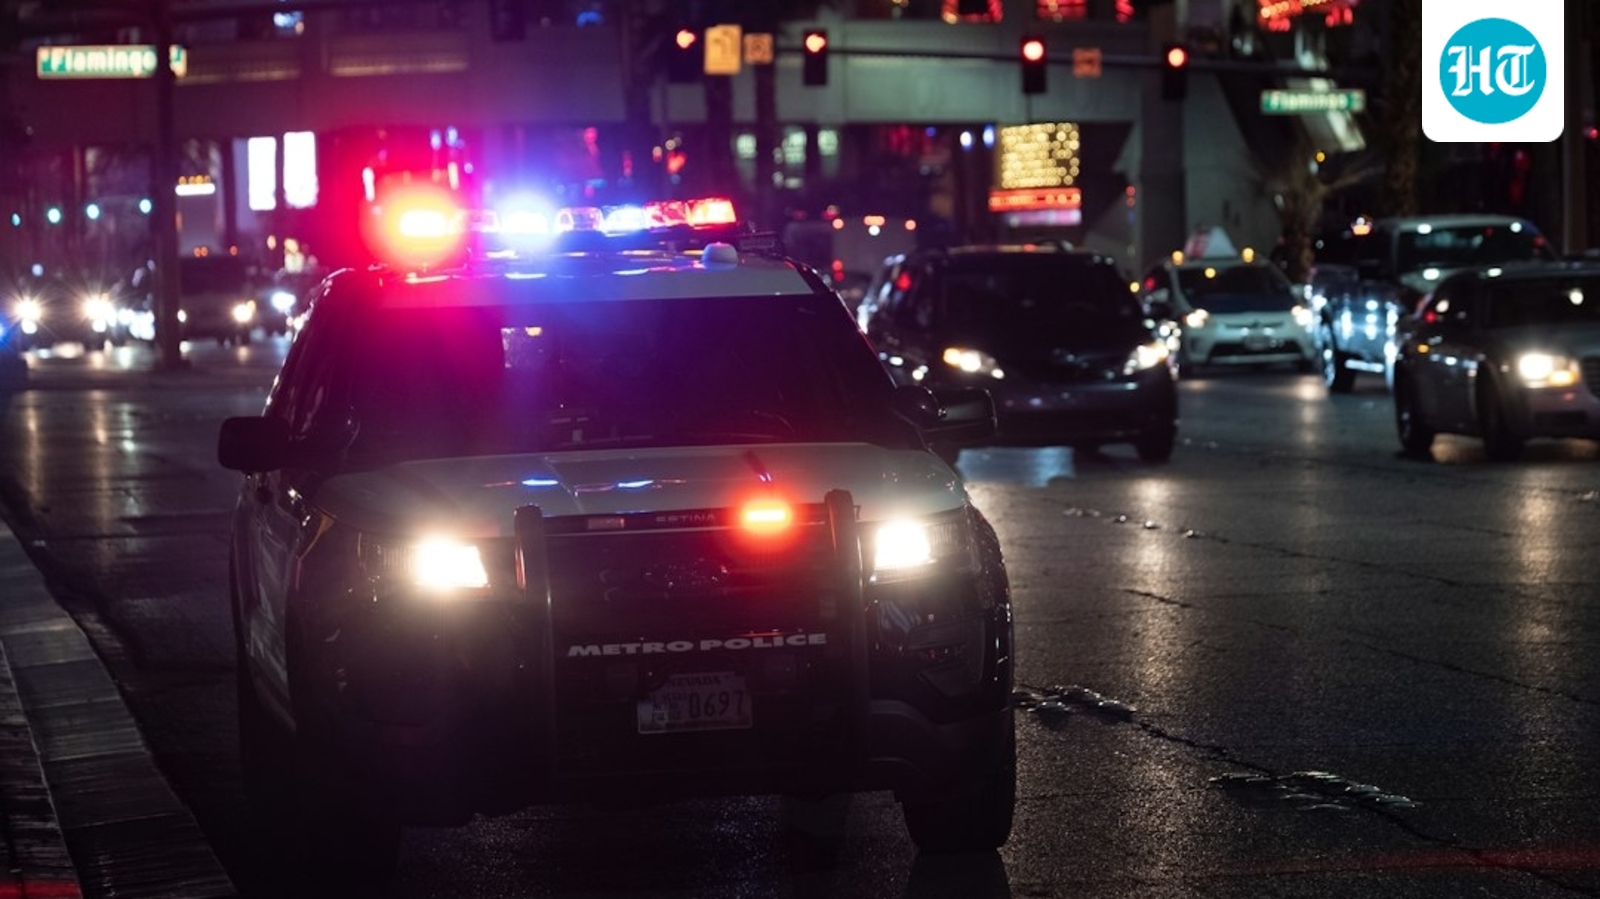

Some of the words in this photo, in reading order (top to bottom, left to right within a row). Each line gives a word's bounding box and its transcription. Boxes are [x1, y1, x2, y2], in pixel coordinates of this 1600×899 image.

[51, 47, 156, 77] Flamingo
[1269, 91, 1348, 111] Flamingo
[567, 640, 694, 657] METRO
[700, 633, 827, 651] POLICE
[668, 675, 721, 687] NEVADA
